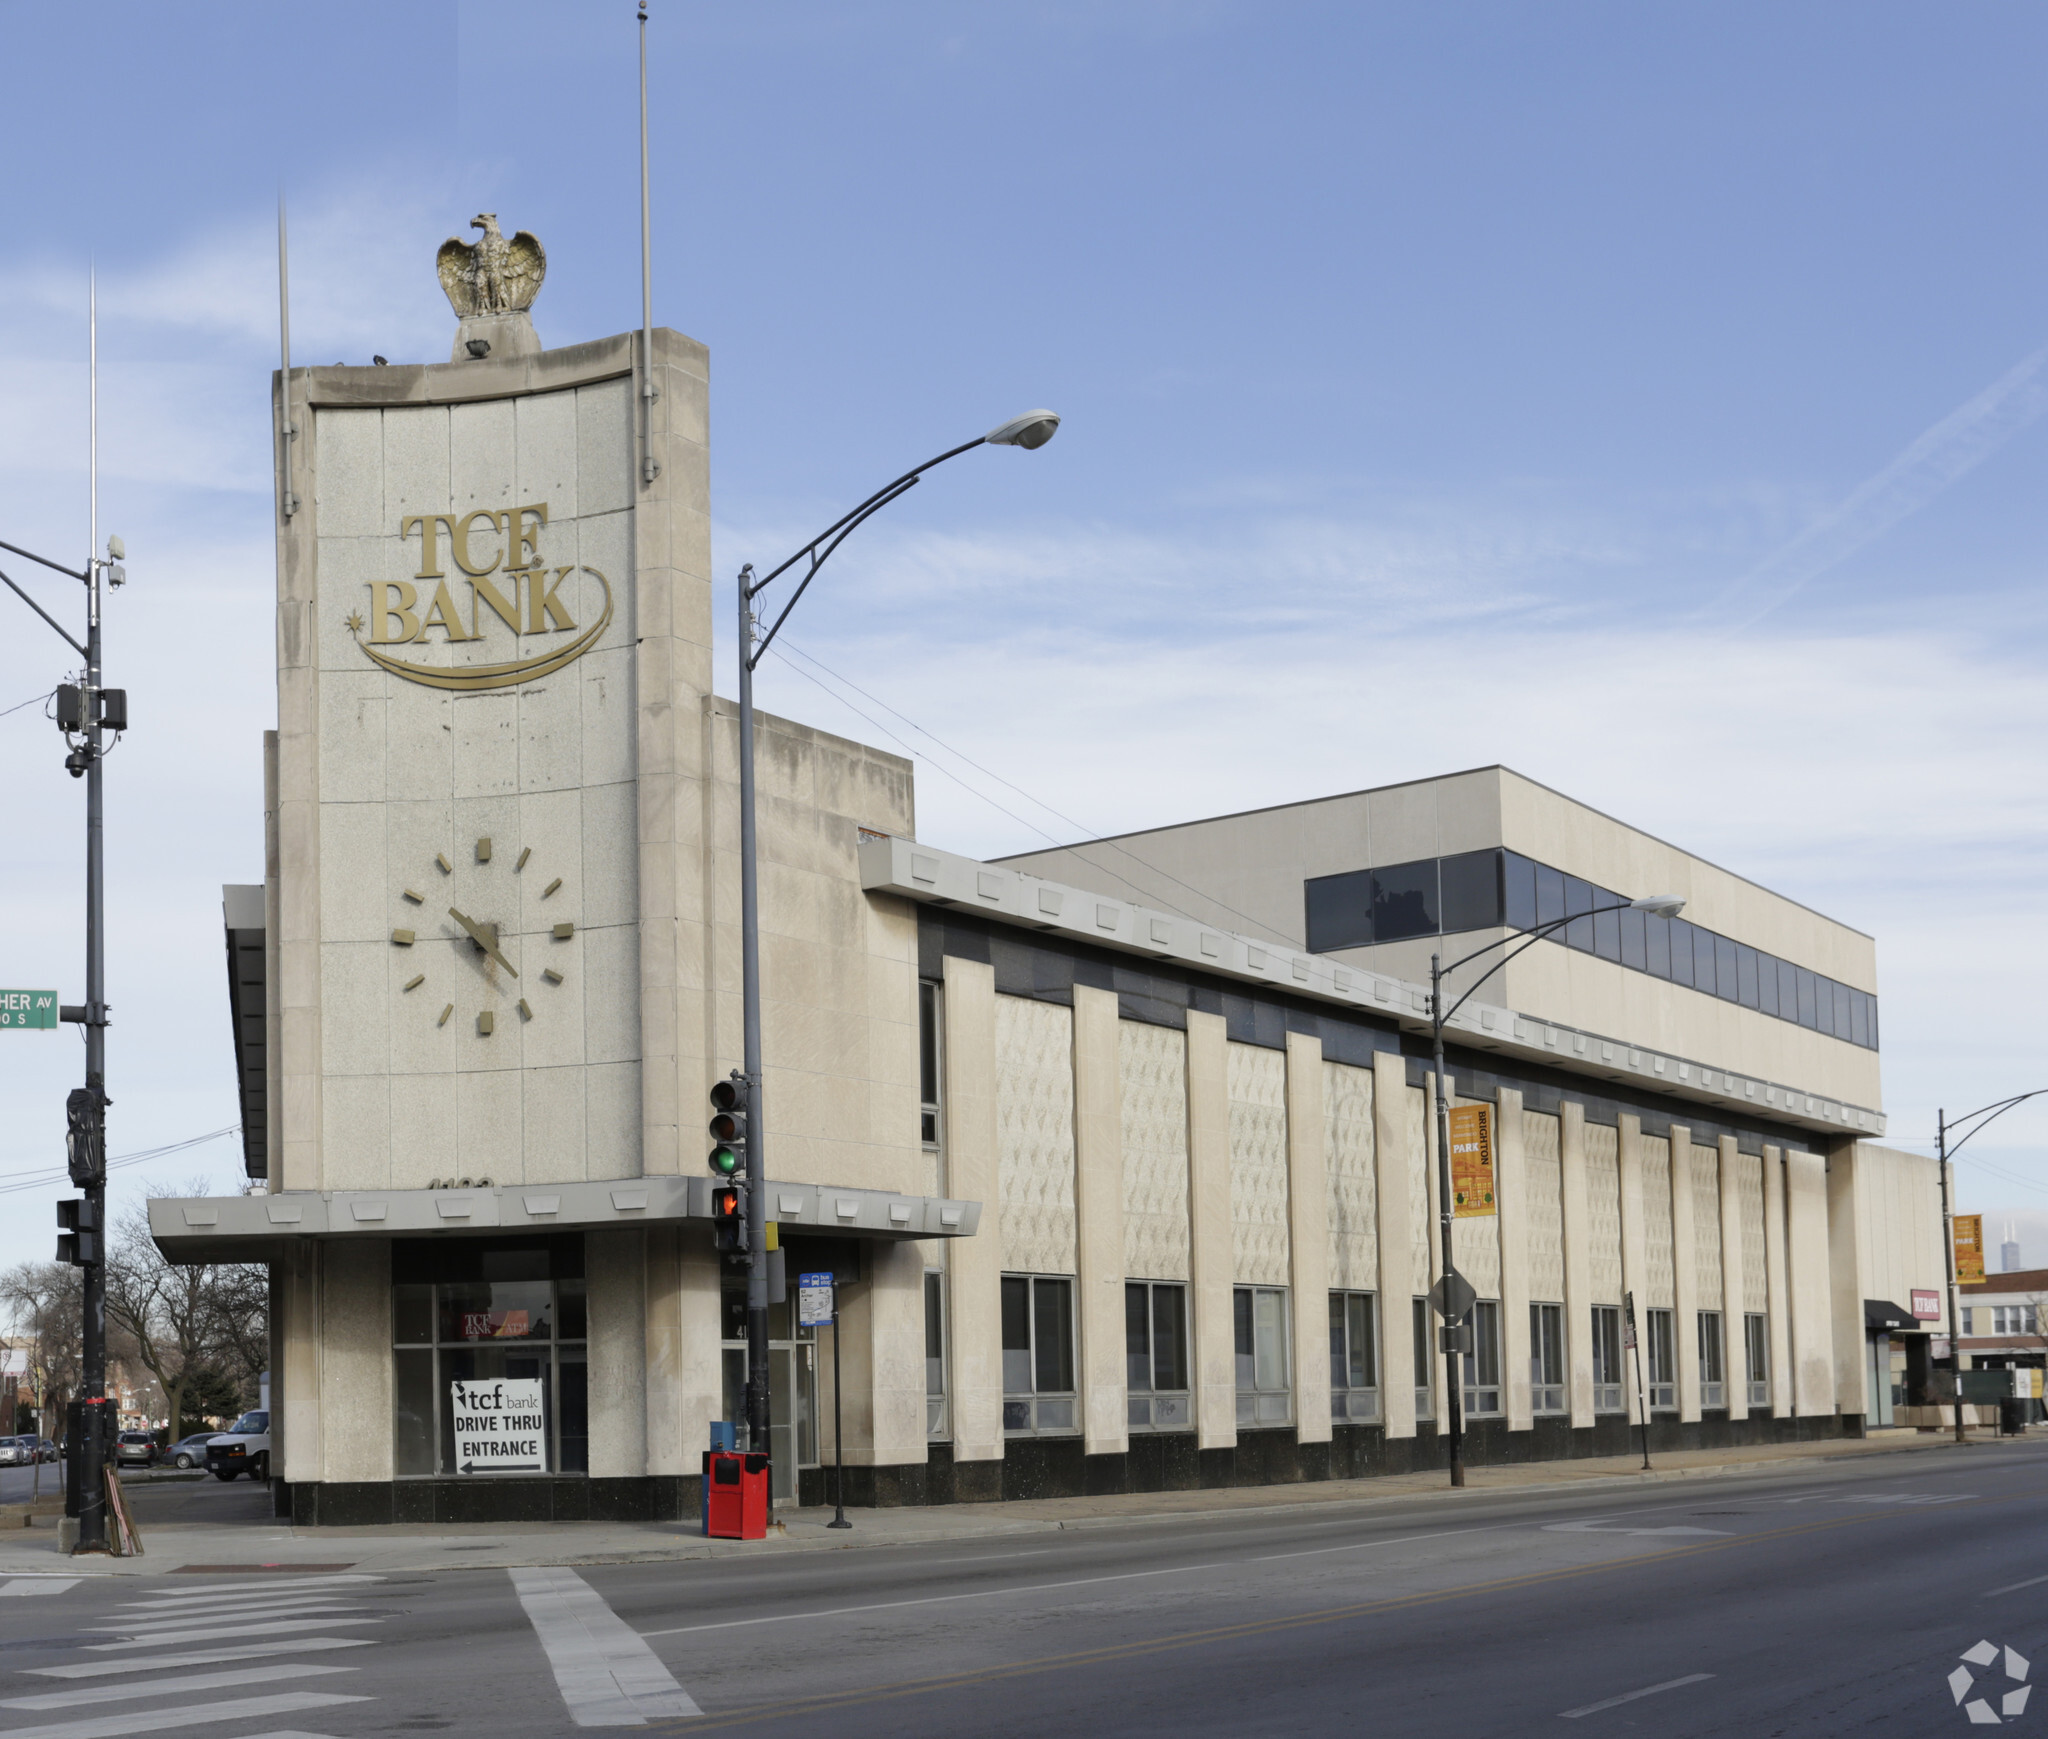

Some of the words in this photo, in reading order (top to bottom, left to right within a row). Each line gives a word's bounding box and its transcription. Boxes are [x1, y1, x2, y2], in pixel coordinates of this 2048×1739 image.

[401, 502, 548, 578] TCF
[364, 565, 578, 644] BANK
[36, 997, 52, 1008] AV
[18, 1013, 26, 1025] S
[1478, 1111, 1489, 1165] BRIGHTON
[1453, 1142, 1480, 1154] PARK
[465, 1314, 491, 1326] TCF
[465, 1325, 491, 1335] BANK
[505, 1323, 528, 1334] ATM
[469, 1384, 503, 1410] tcf
[506, 1394, 538, 1409] bank
[456, 1416, 498, 1432] DRIVE
[503, 1415, 542, 1431] THRU
[463, 1440, 538, 1457] ENTRANCE
